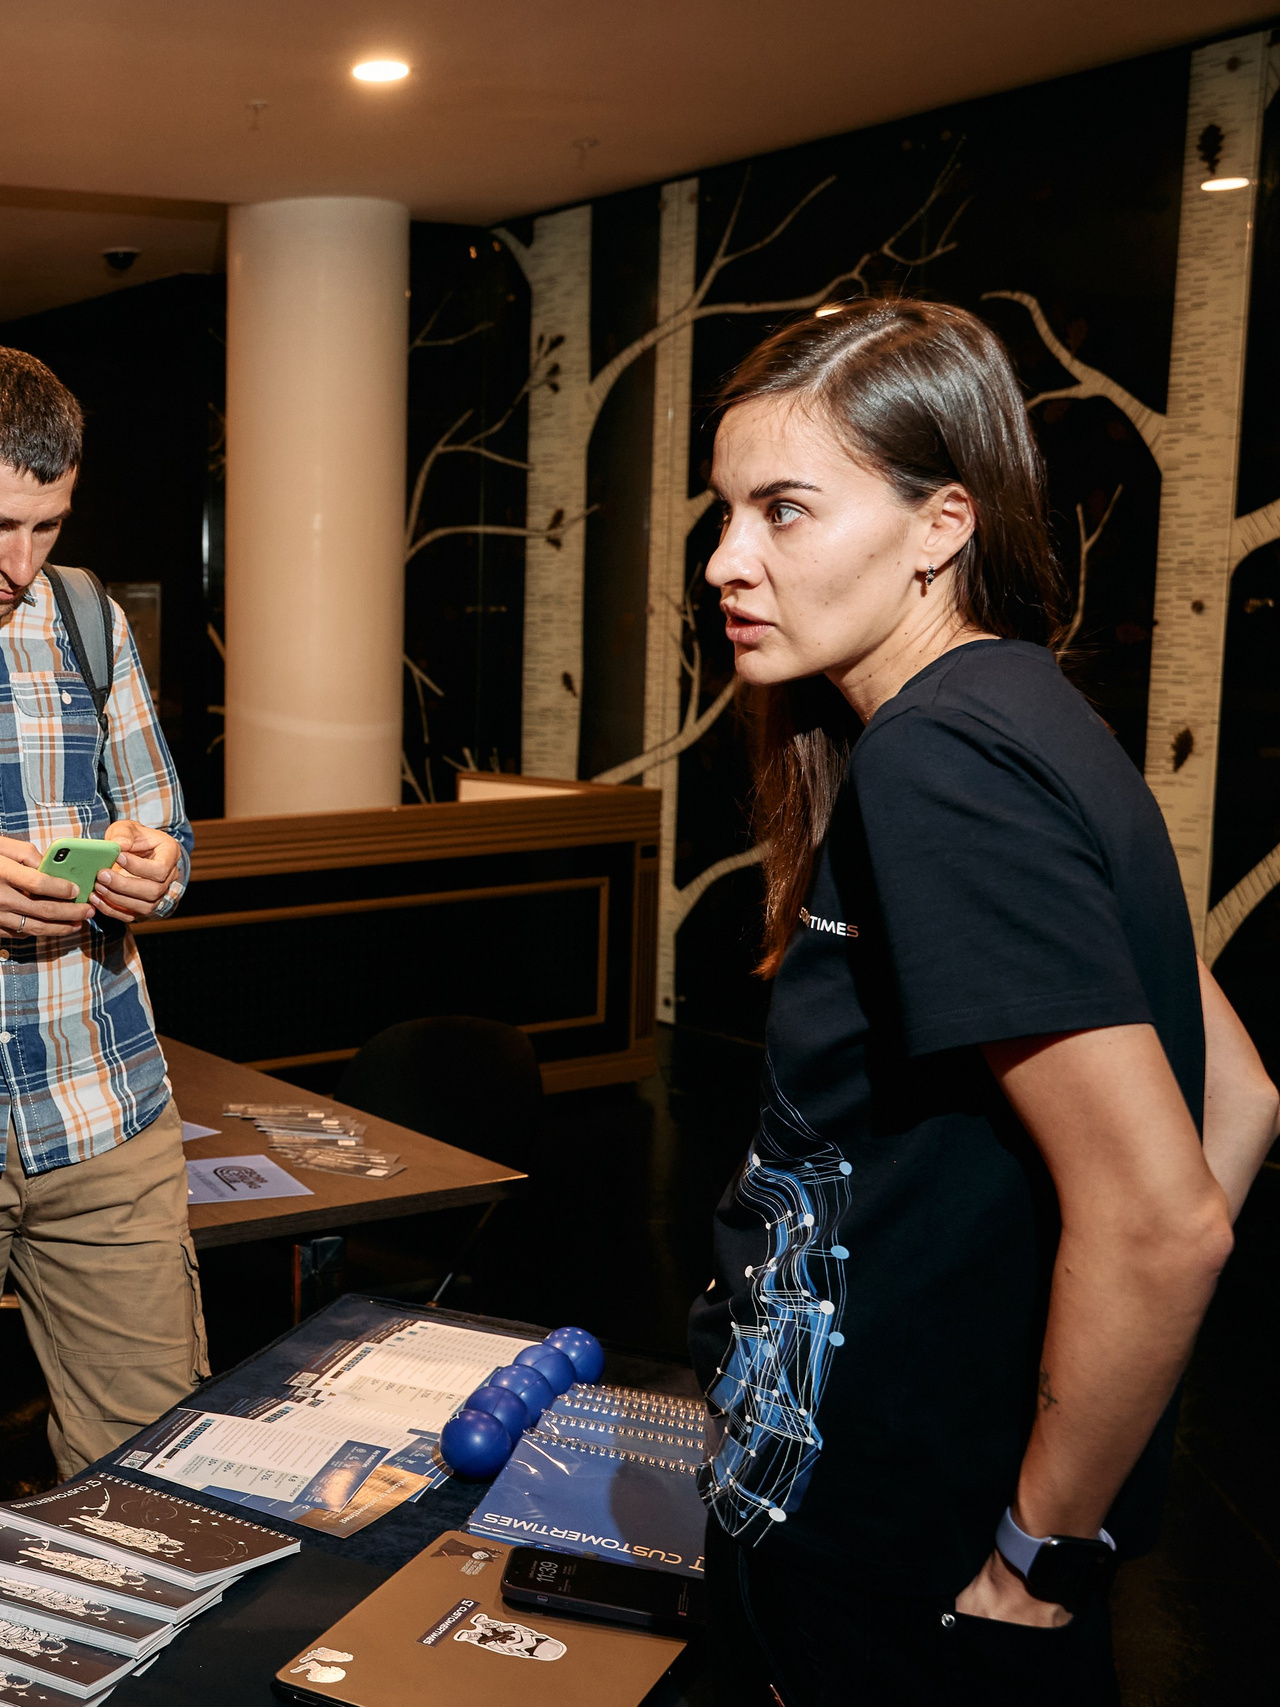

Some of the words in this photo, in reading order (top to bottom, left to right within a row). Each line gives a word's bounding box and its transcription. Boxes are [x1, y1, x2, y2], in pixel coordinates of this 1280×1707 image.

[800, 907, 859, 938] TIMES
[208, 1458, 218, 1466] 10+
[223, 1462, 235, 1472] 100+
[10, 1486, 89, 1509] CUSTOMERTIMES
[483, 1512, 682, 1564] CUSTOMERTIMES
[536, 1561, 559, 1583] 11:39
[423, 1605, 467, 1645] CUSTOMERTIMES
